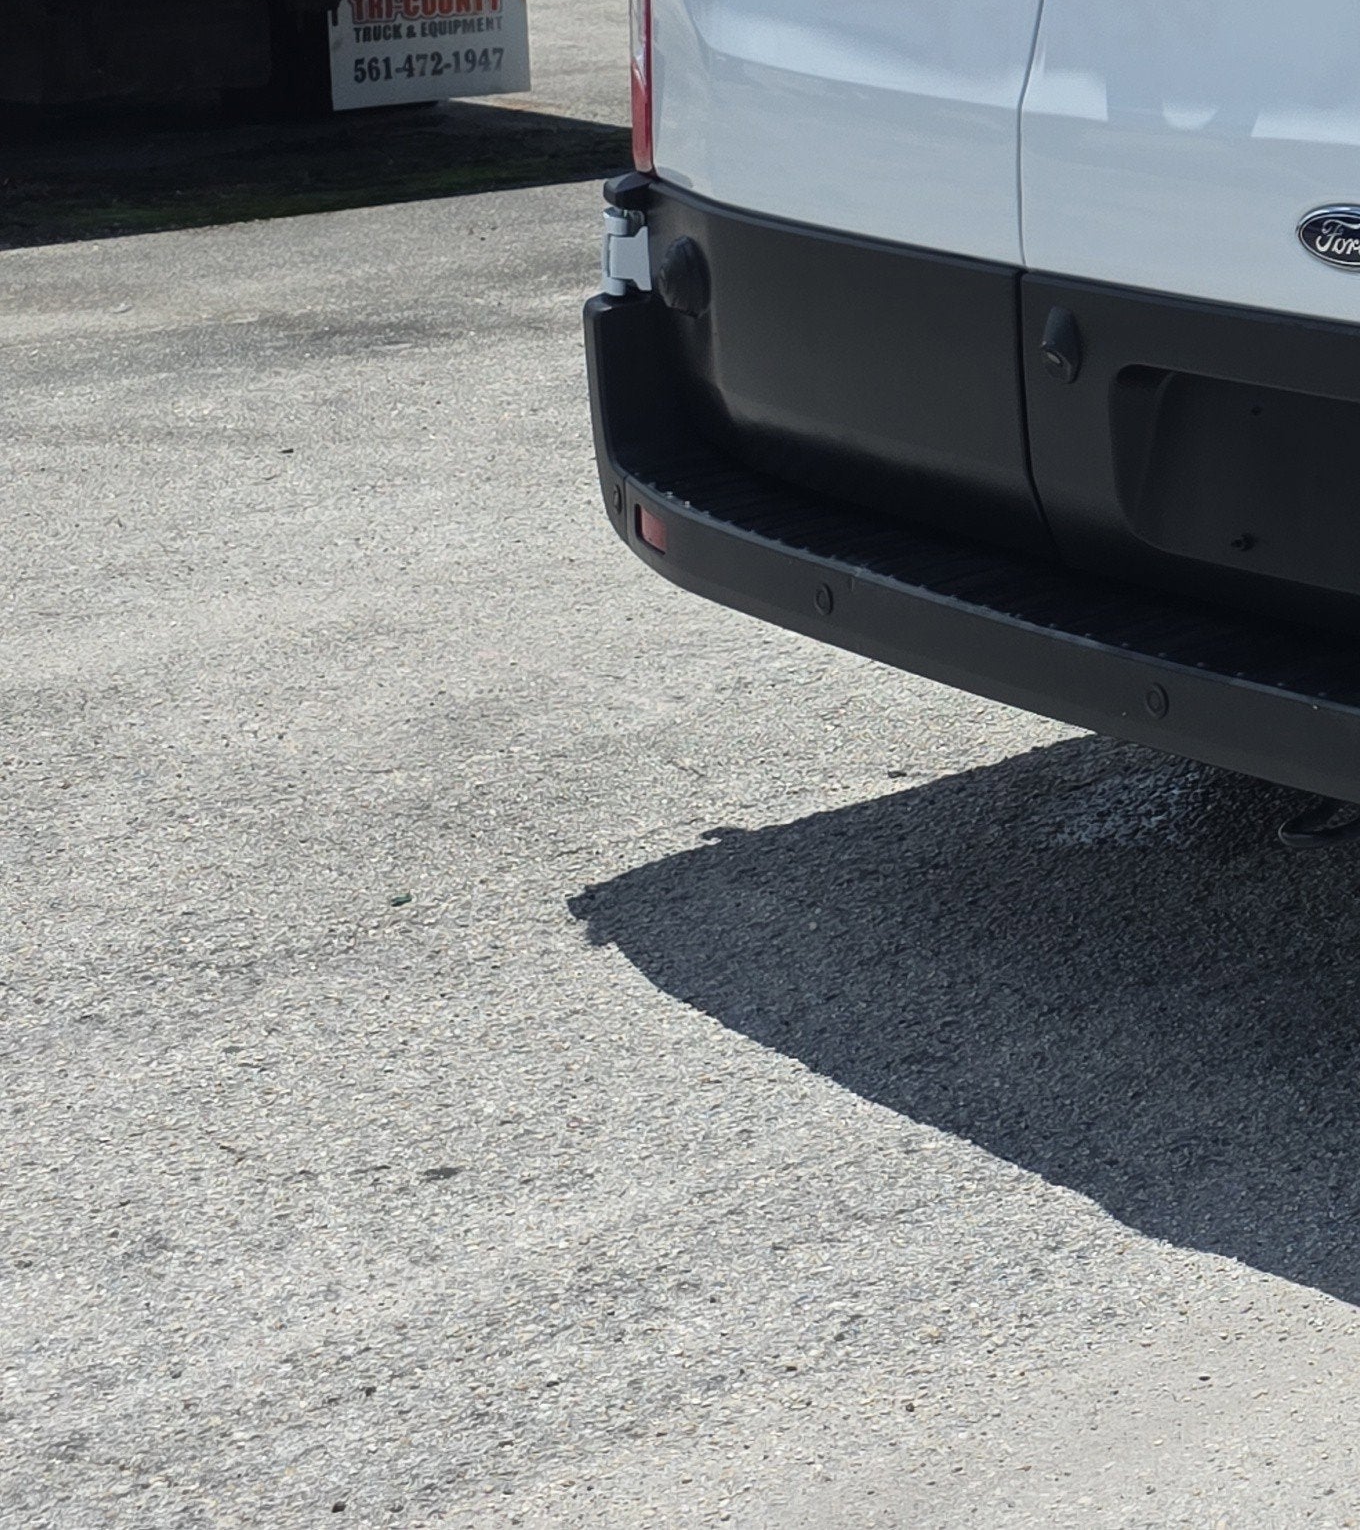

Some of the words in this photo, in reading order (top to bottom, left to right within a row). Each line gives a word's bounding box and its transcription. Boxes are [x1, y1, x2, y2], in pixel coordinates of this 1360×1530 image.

[353, 23, 404, 44] TRUCK
[405, 24, 418, 40] &
[420, 16, 504, 40] EQUIPMENT
[353, 47, 505, 84] 561-472-1947
